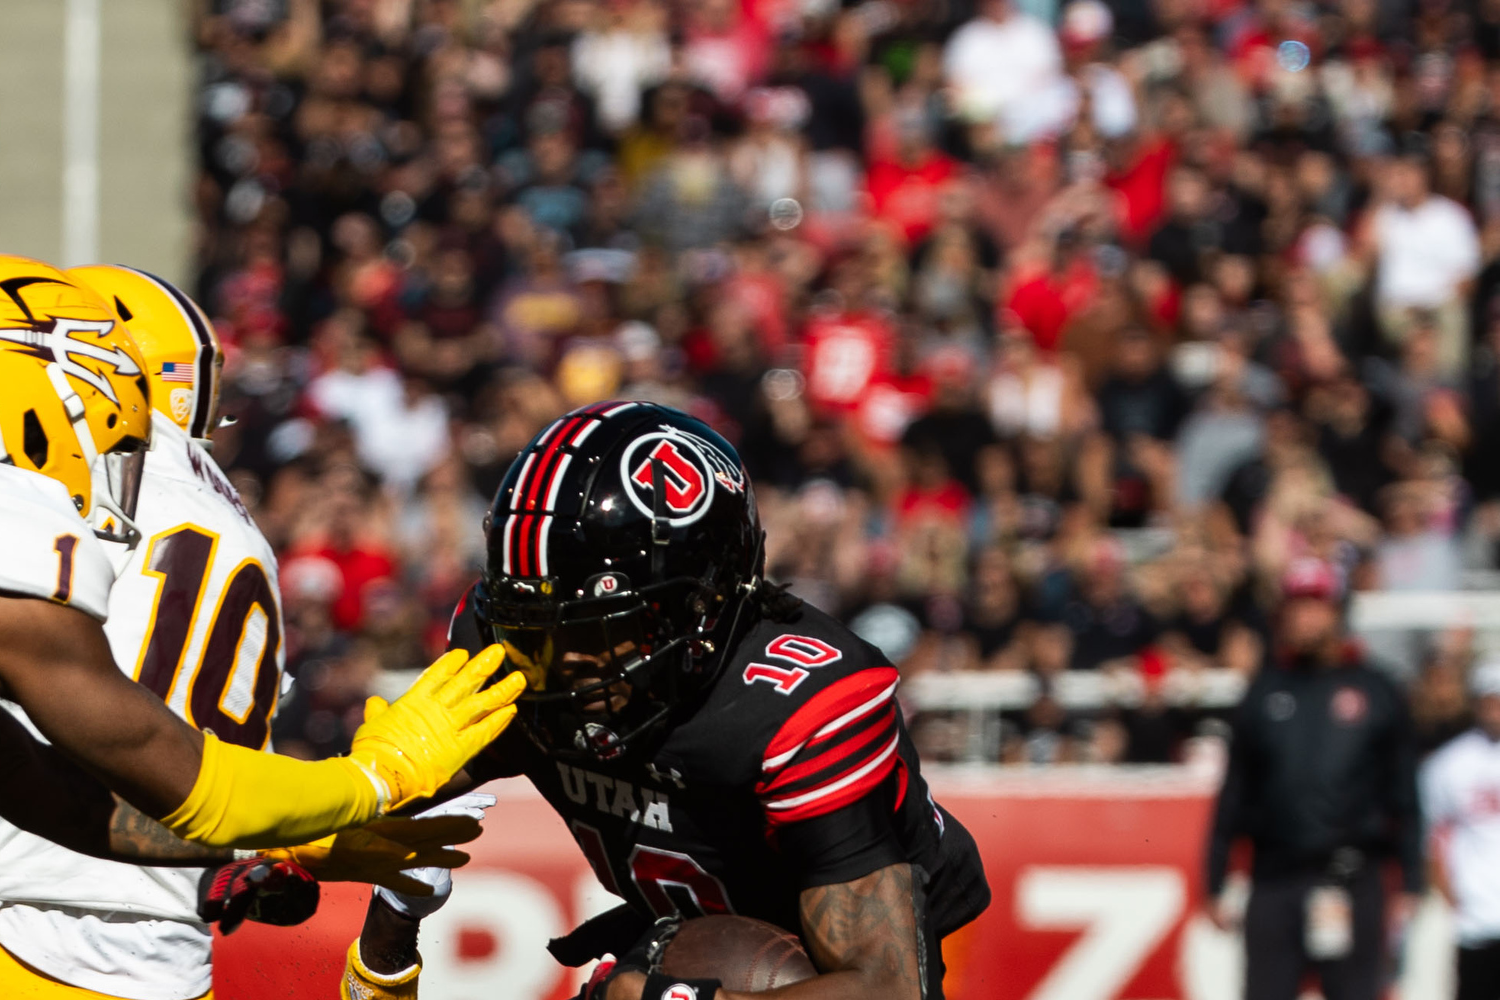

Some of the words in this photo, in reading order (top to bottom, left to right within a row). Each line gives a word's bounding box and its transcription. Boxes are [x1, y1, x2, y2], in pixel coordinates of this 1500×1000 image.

[631, 438, 706, 513] U
[52, 532, 80, 605] 1
[132, 521, 283, 752] 10
[742, 633, 843, 697] 10
[555, 760, 674, 833] UTAH
